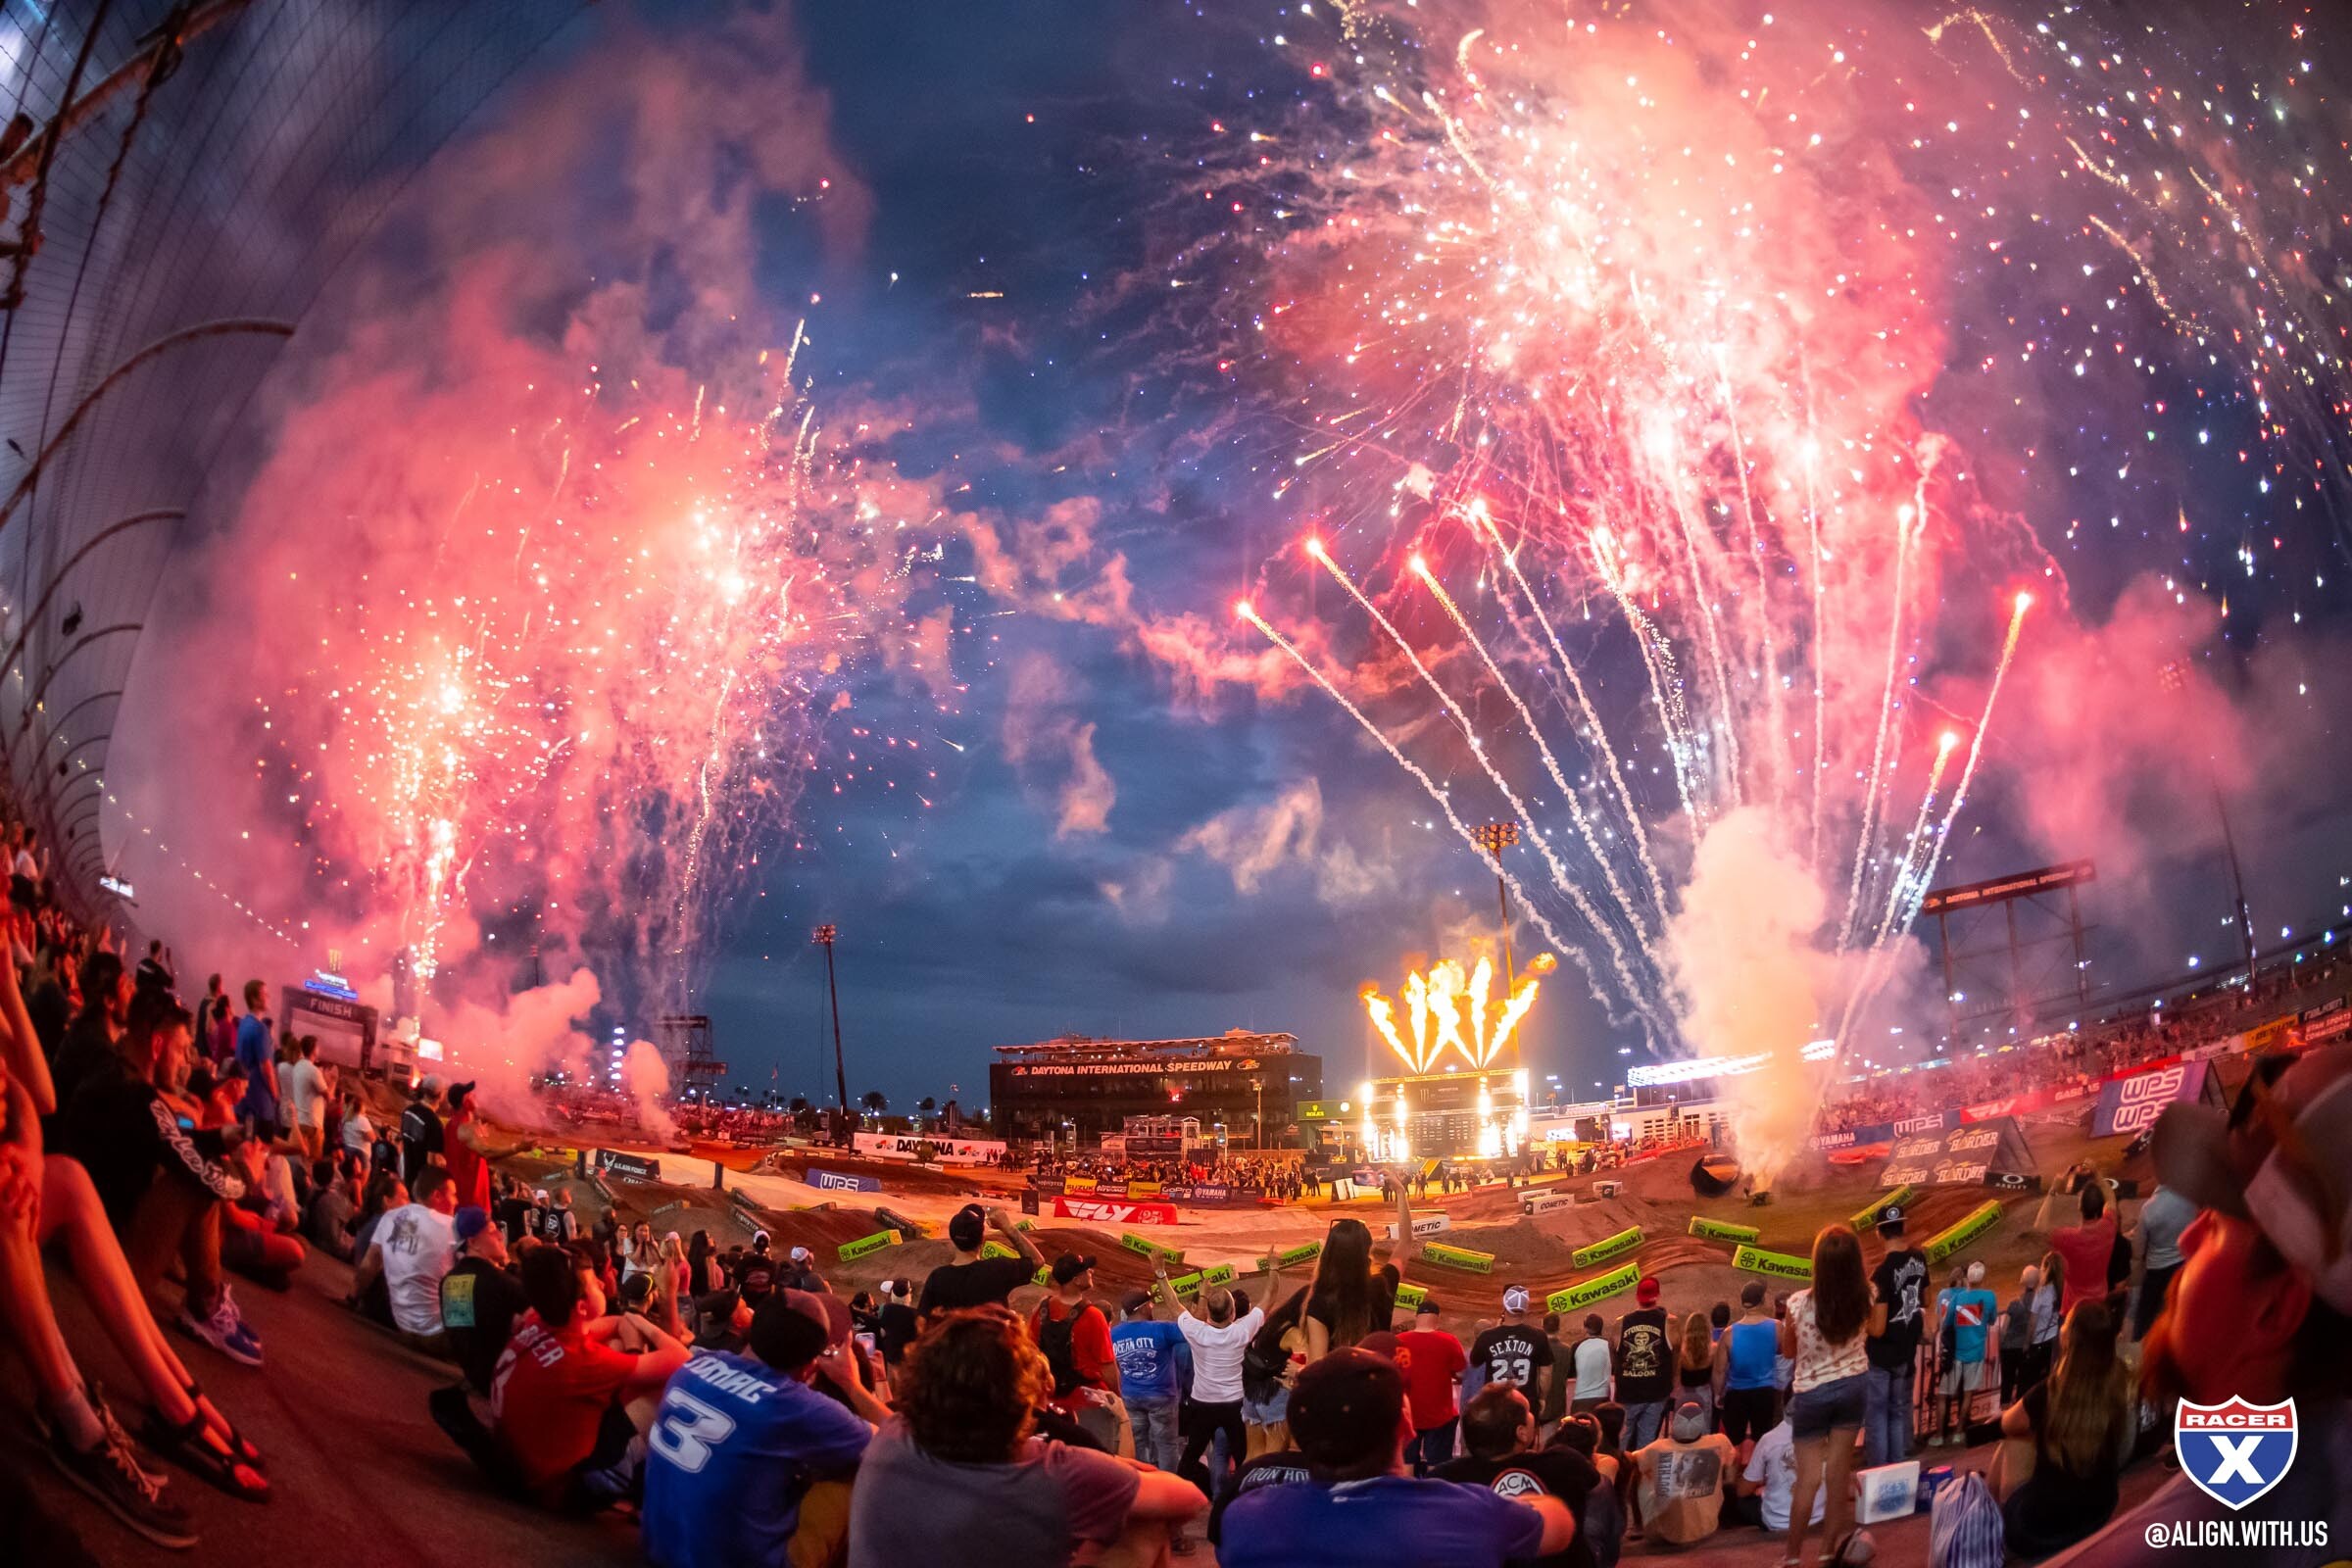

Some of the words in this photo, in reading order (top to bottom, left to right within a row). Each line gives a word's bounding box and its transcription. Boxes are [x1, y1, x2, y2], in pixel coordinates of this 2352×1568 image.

[310, 999, 353, 1017] FINISH
[1031, 1065, 1074, 1075] DAYTONA
[1077, 1063, 1163, 1075] INTERNATIONAL
[1166, 1060, 1232, 1072] SPEEDWAY
[2121, 1066, 2184, 1103] WPS
[1820, 1133, 1855, 1146] YAMAHA
[820, 1173, 859, 1192] WPS
[1161, 1186, 1192, 1195] GoPro
[1202, 1188, 1226, 1197] YAMAHA
[1540, 1199, 1569, 1209] COMETIC
[851, 1236, 891, 1255] Kawasaki
[1708, 1228, 1757, 1244] Kawasaki
[1134, 1240, 1176, 1262] Kawaki
[1278, 1245, 1320, 1265] awasaki
[1589, 1234, 1642, 1261] Kawasaki
[1438, 1253, 1490, 1271] Kawasaki
[1757, 1257, 1812, 1278] Kawasa
[1569, 1270, 1640, 1305] Kawasaki
[1112, 1340, 1135, 1356] OCEAN
[1137, 1337, 1154, 1348] CITY
[1489, 1339, 1535, 1357] SEXTON
[1491, 1358, 1531, 1386] 23
[649, 1386, 737, 1474] 3
